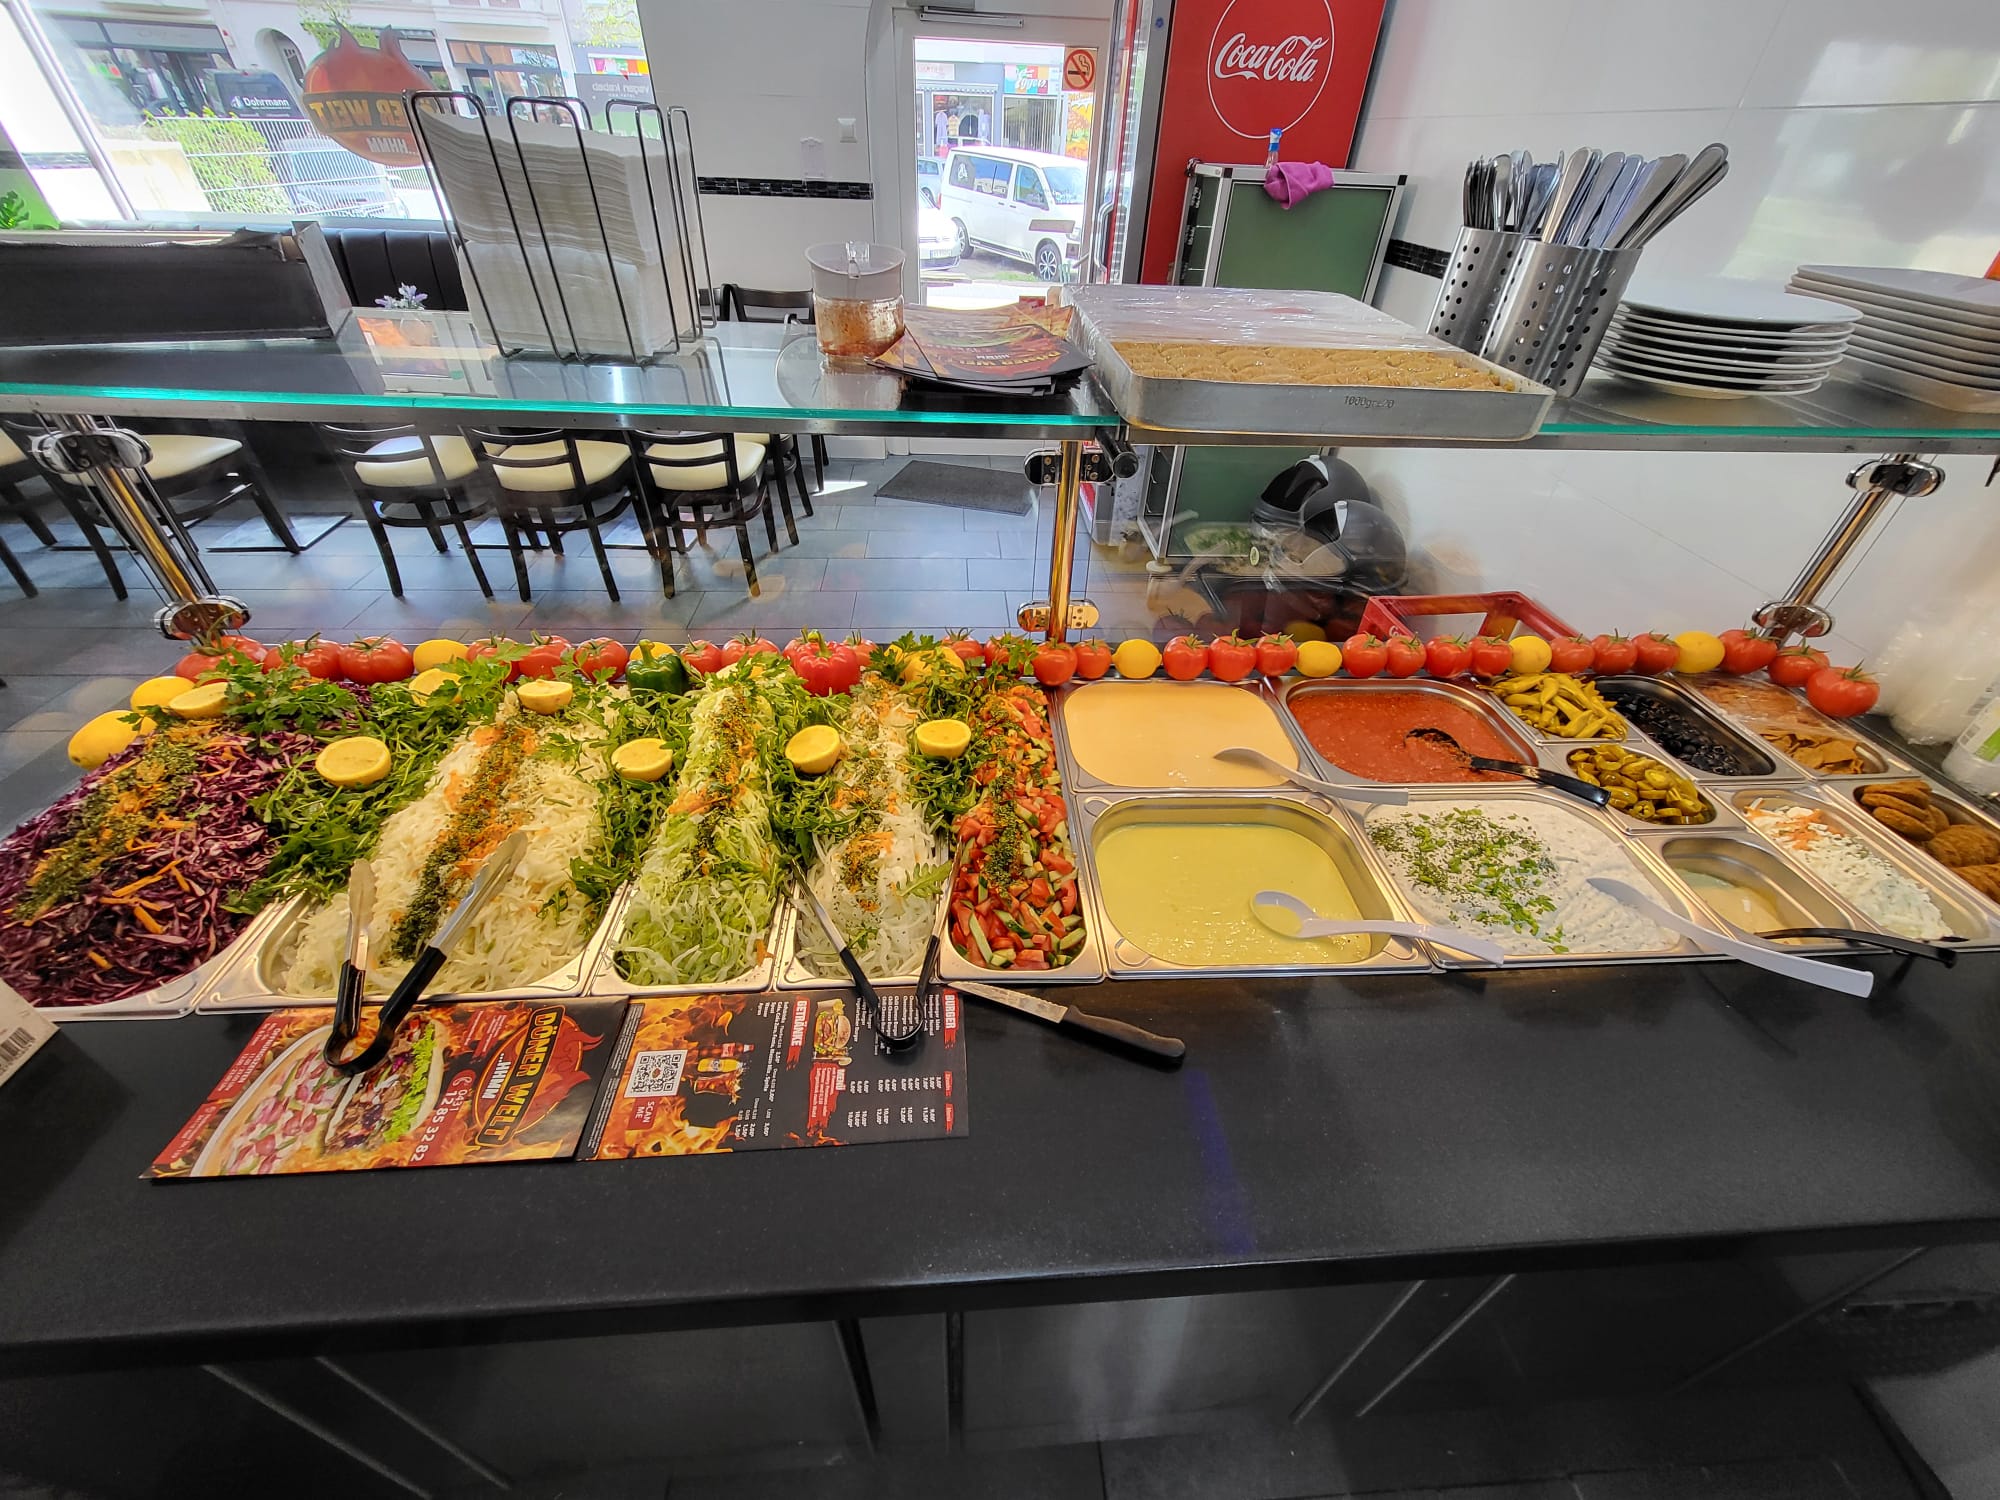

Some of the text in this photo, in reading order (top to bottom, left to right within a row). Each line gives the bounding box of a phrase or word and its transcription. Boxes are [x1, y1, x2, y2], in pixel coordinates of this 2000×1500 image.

[1215, 33, 1329, 82] Coca-Cola
[243, 97, 289, 107] Dohrmann
[791, 1001, 808, 1046] GETRÄNKE
[945, 995, 956, 1029] BURGER
[517, 1012, 558, 1077] DÖNER
[836, 1069, 846, 1091] MENÜ
[450, 1089, 468, 1111] 0431
[485, 1081, 532, 1139] WELT
[635, 1106, 643, 1119] ME
[643, 1101, 655, 1123] SCAN
[410, 1091, 456, 1162] 12 85 32 82
